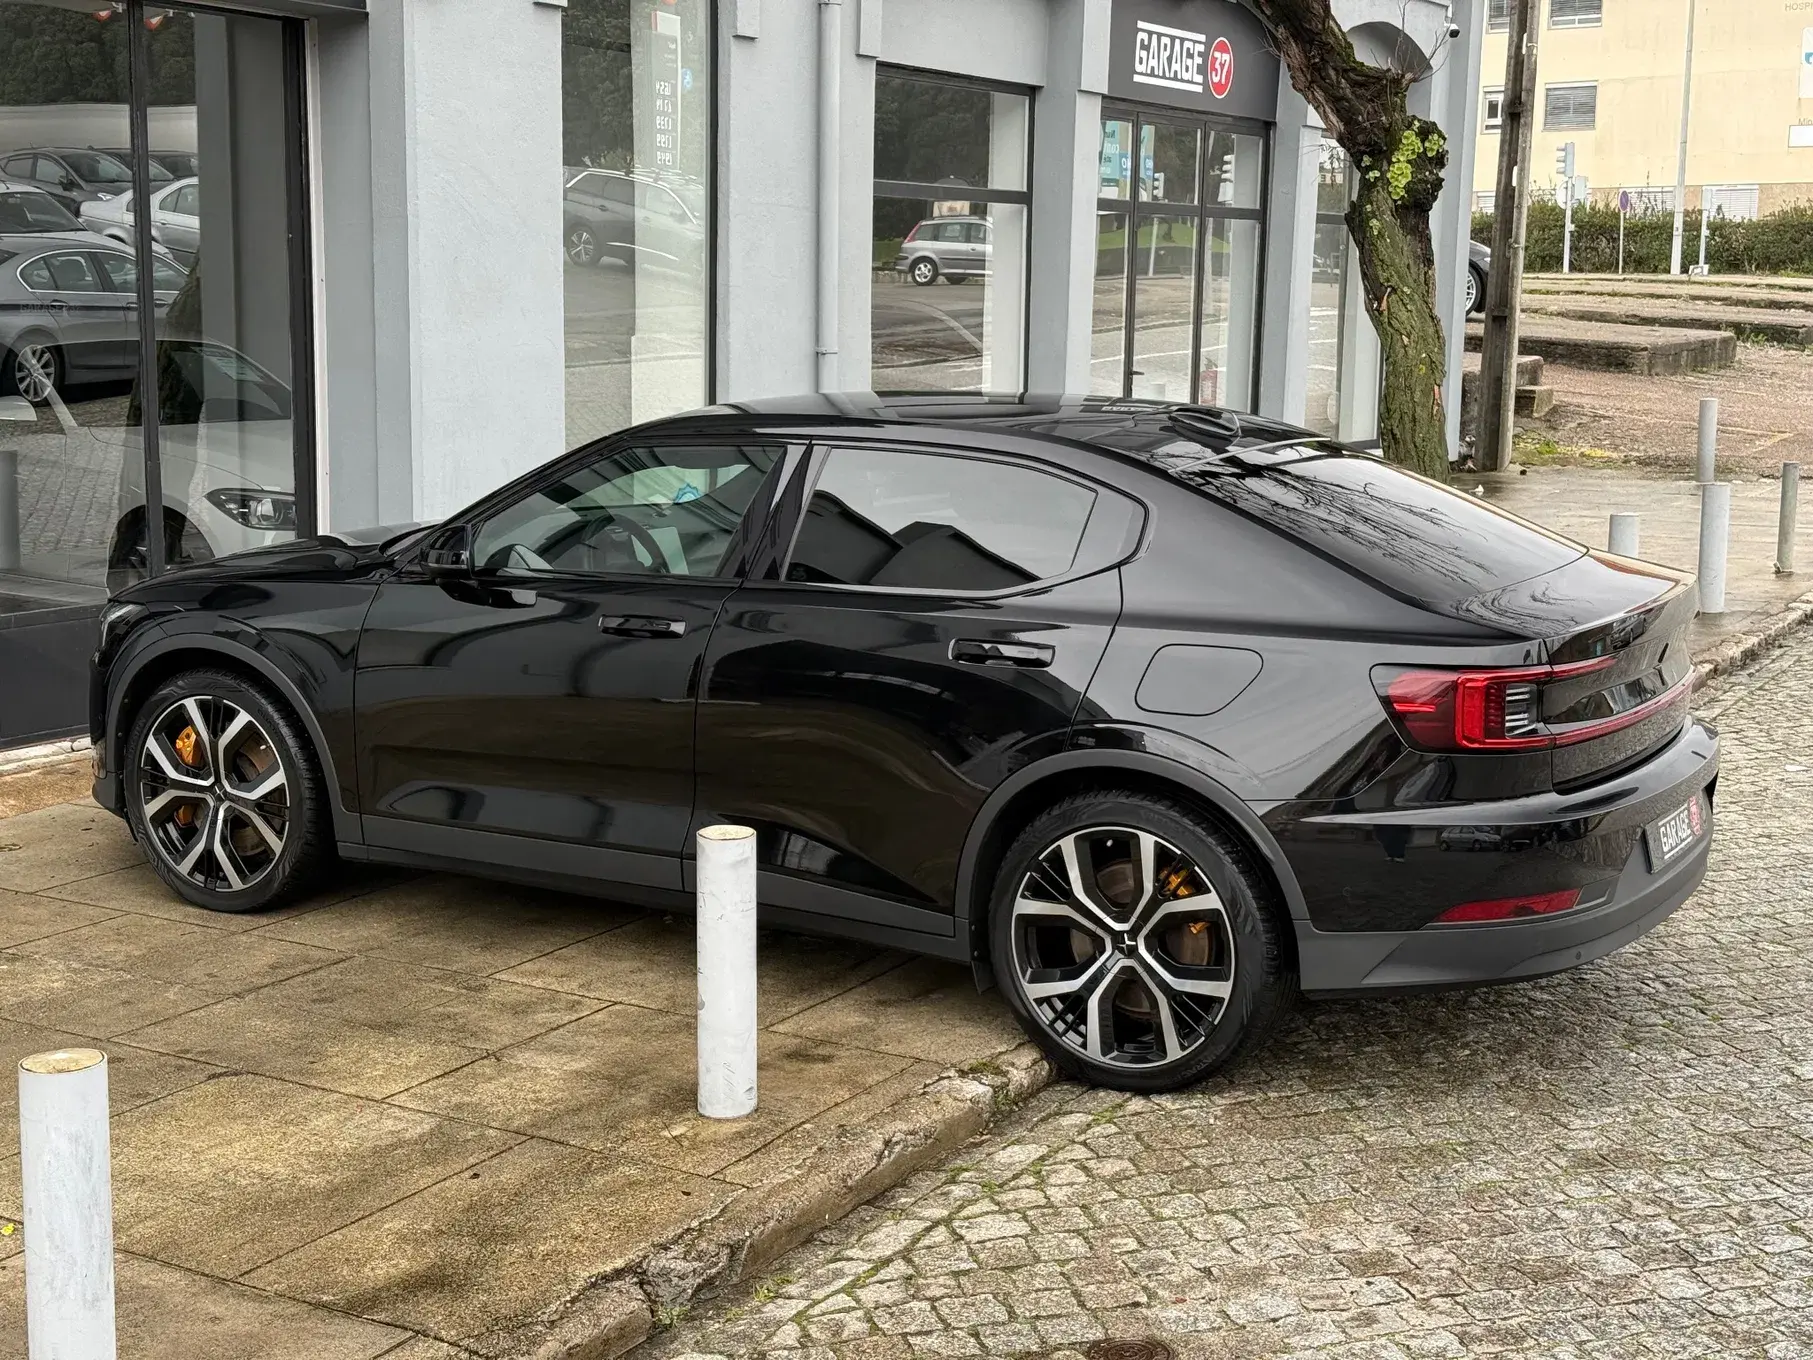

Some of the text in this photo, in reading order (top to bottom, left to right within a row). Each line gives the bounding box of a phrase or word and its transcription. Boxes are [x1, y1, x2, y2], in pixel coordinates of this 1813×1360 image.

[1134, 31, 1231, 85] GARAGE 37
[1659, 809, 1693, 853] GARAGE
